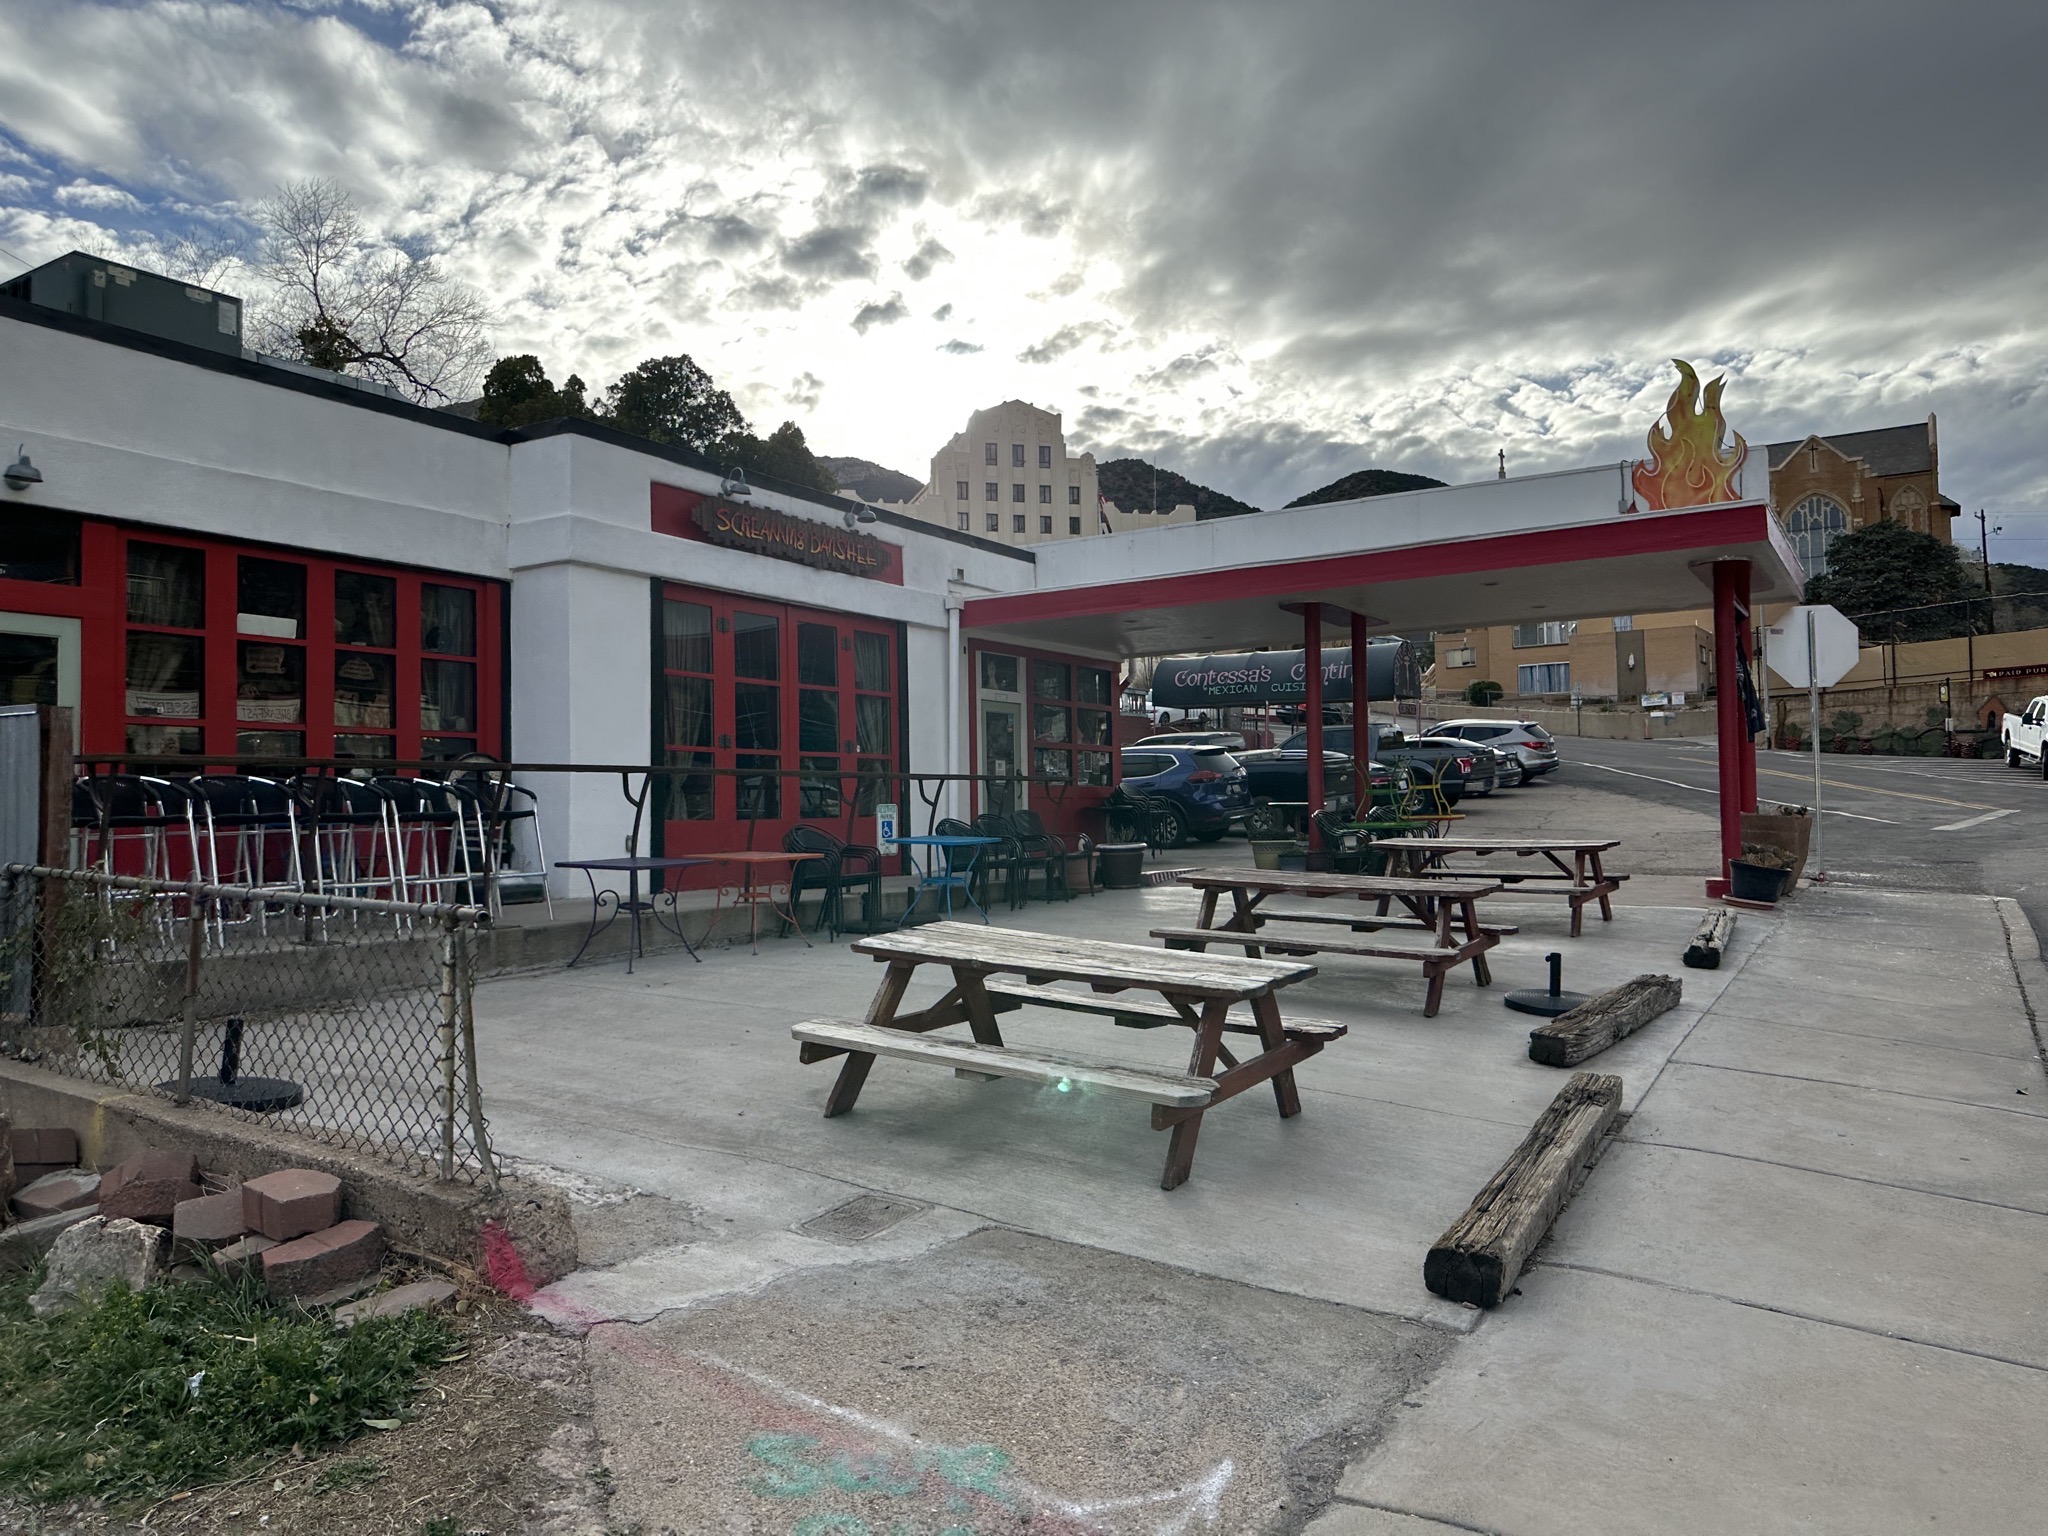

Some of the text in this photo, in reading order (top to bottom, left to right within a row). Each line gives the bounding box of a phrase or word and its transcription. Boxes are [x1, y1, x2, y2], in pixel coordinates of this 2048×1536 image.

[1174, 661, 1353, 691] Contessa's Cntin
[1998, 669, 2022, 677] PAID
[1208, 682, 1307, 695] MEXICAN CUISI
